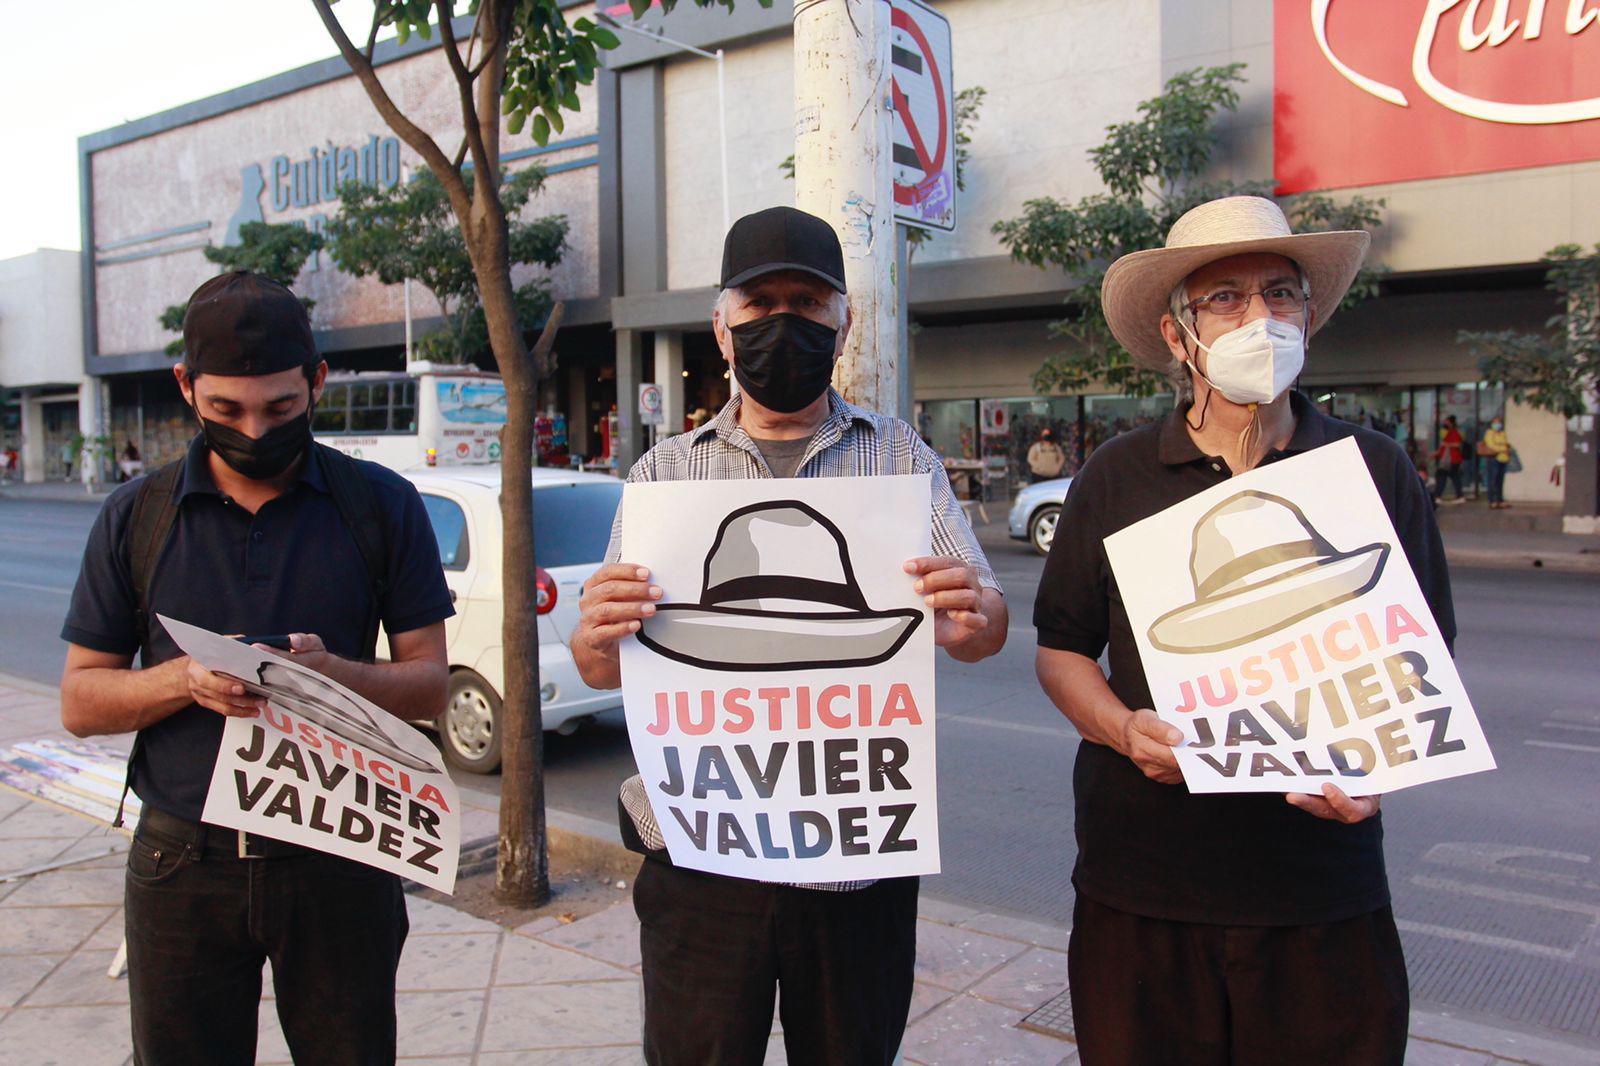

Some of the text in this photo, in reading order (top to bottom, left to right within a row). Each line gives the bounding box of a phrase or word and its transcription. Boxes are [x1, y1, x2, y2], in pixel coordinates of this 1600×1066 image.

[271, 133, 400, 212] Cuidado
[1175, 604, 1427, 713] JUSTICIA
[1188, 651, 1442, 749] JAVIER
[646, 684, 923, 736] JUSTICIA
[1196, 706, 1466, 778] VALDEZ
[236, 725, 442, 840] JAVIER
[260, 704, 450, 813] USTICIA
[659, 737, 912, 800] JAVIER
[234, 769, 443, 874] VALDEZ
[669, 804, 918, 859] VALDEZ
